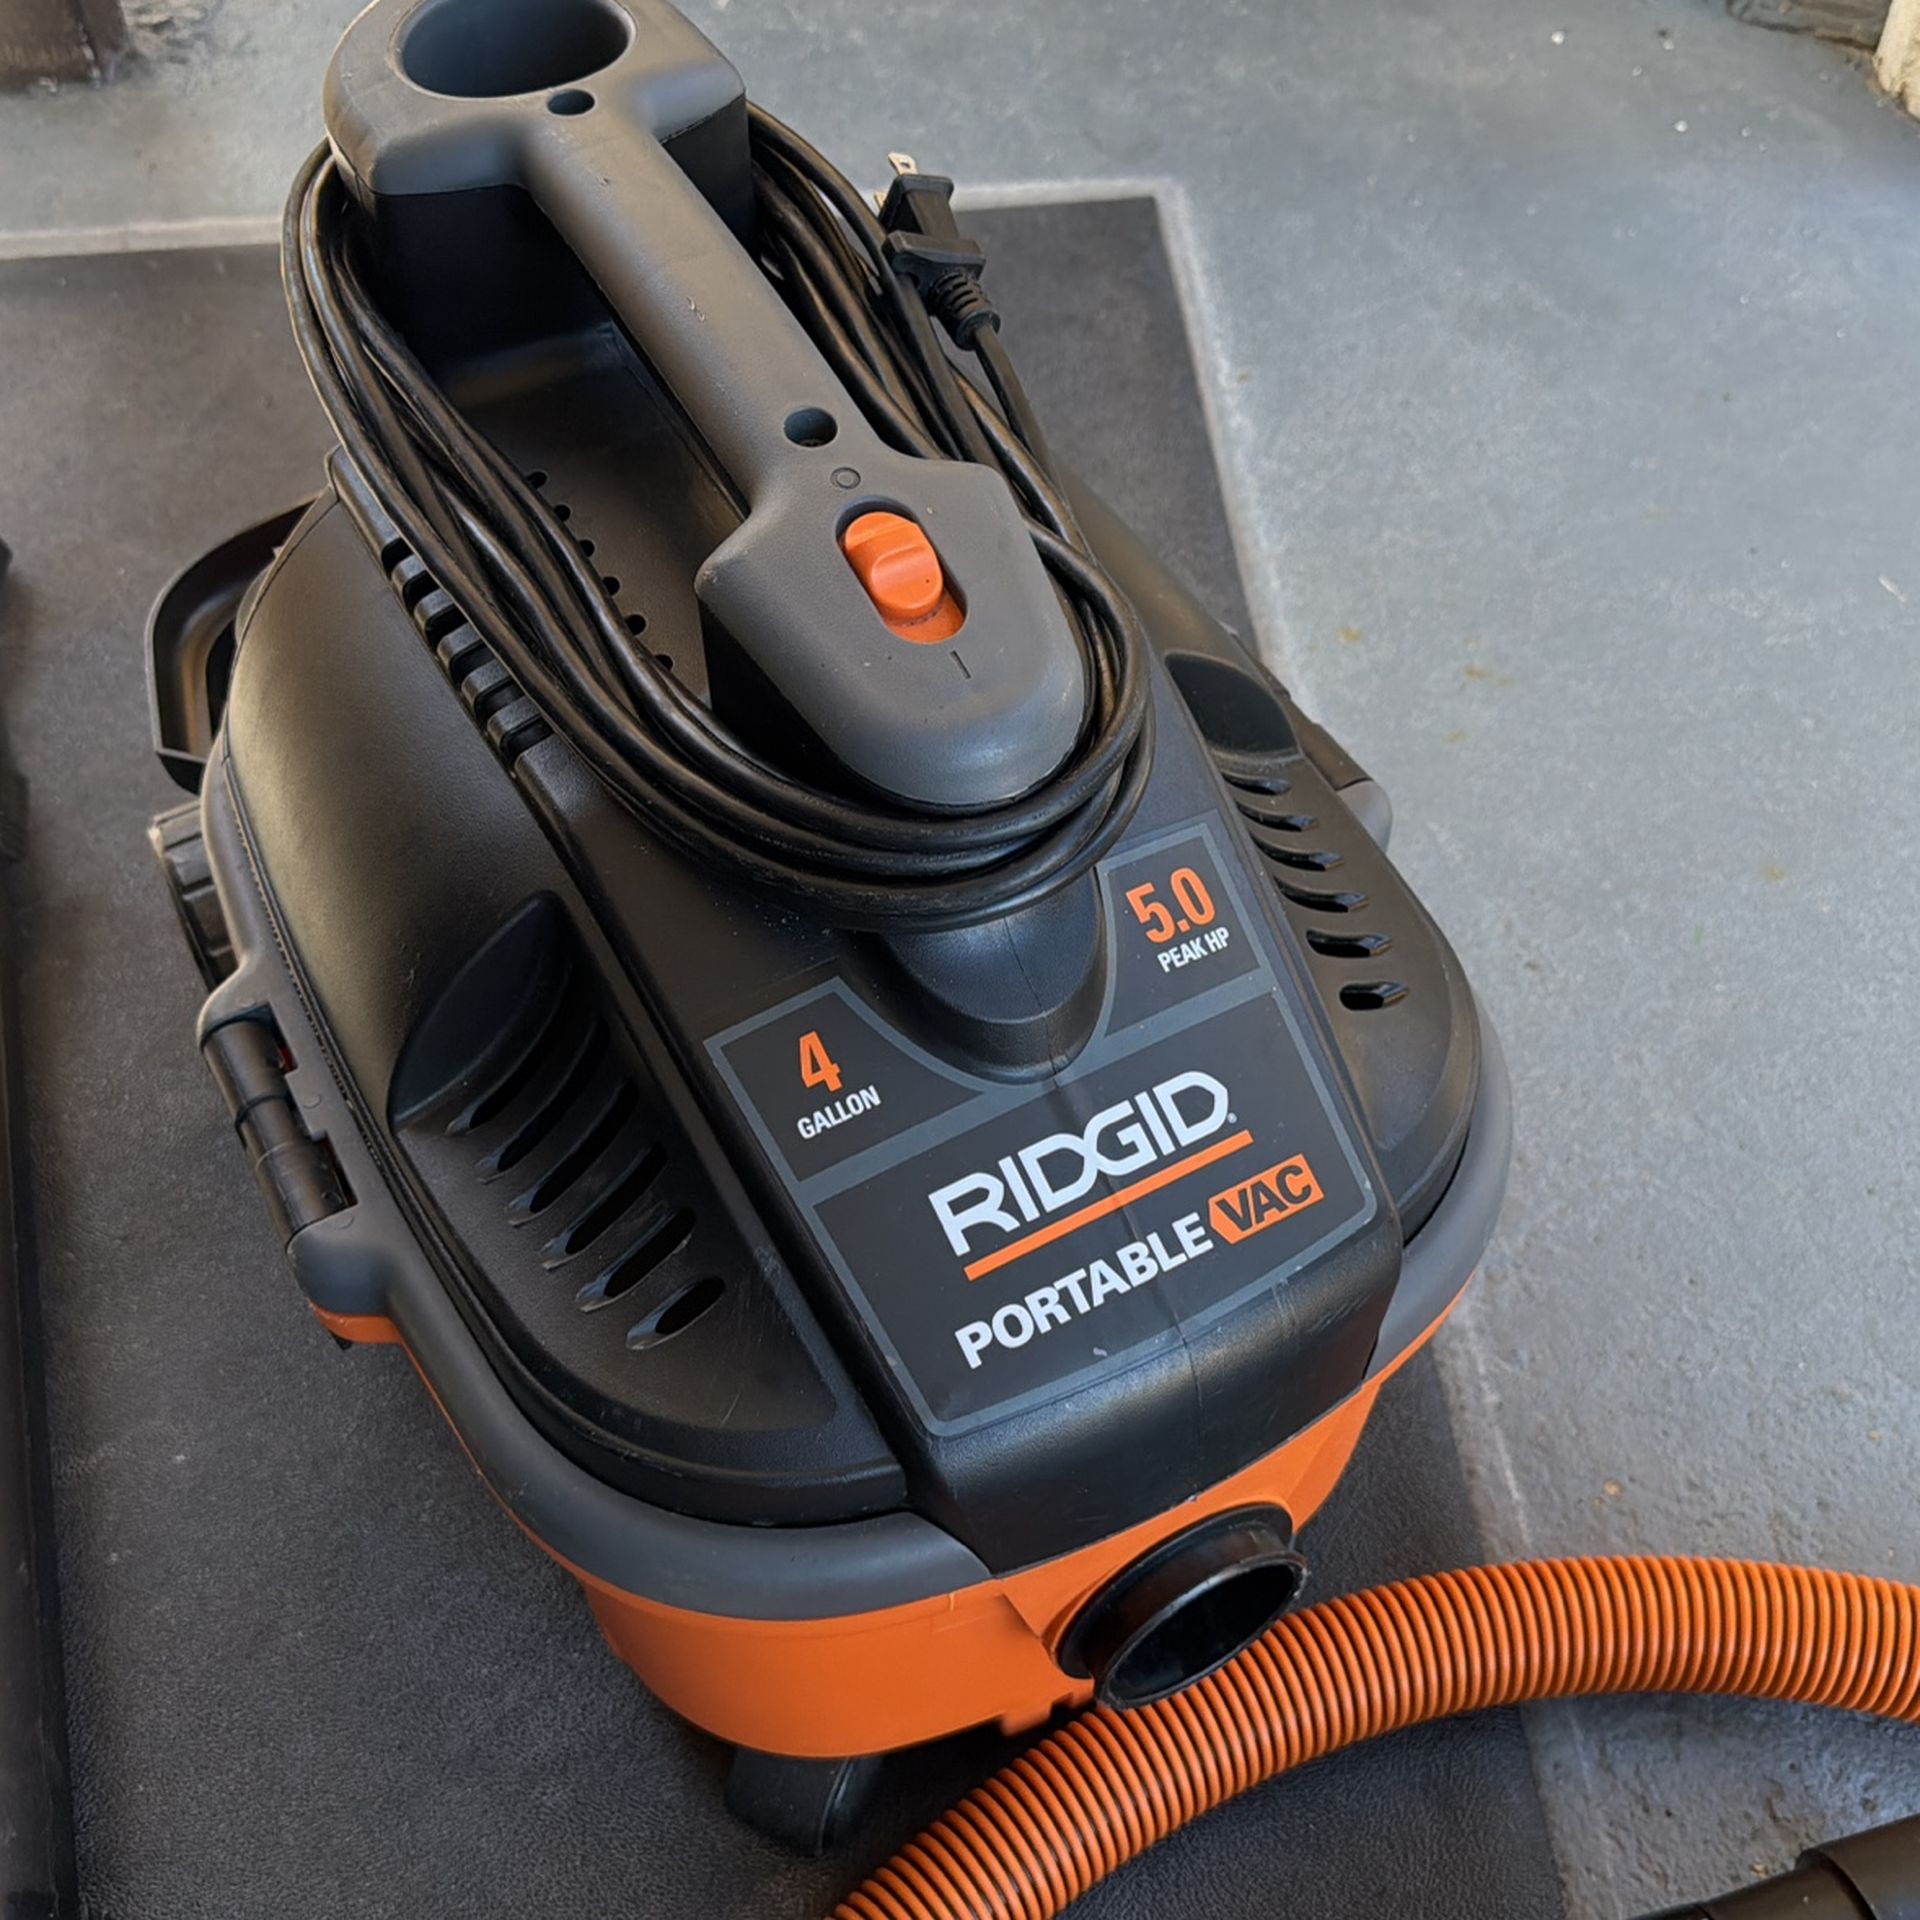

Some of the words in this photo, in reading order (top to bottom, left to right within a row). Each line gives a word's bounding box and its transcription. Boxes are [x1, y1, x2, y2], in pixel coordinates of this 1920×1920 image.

[1125, 867, 1216, 943] 5.0
[1157, 937, 1208, 973] PEAK
[1203, 926, 1230, 952] HP
[800, 1031, 843, 1092] 4
[797, 1085, 881, 1139] GALLON
[954, 1211, 1214, 1369] PORTABLE
[1215, 1165, 1312, 1232] VAC
